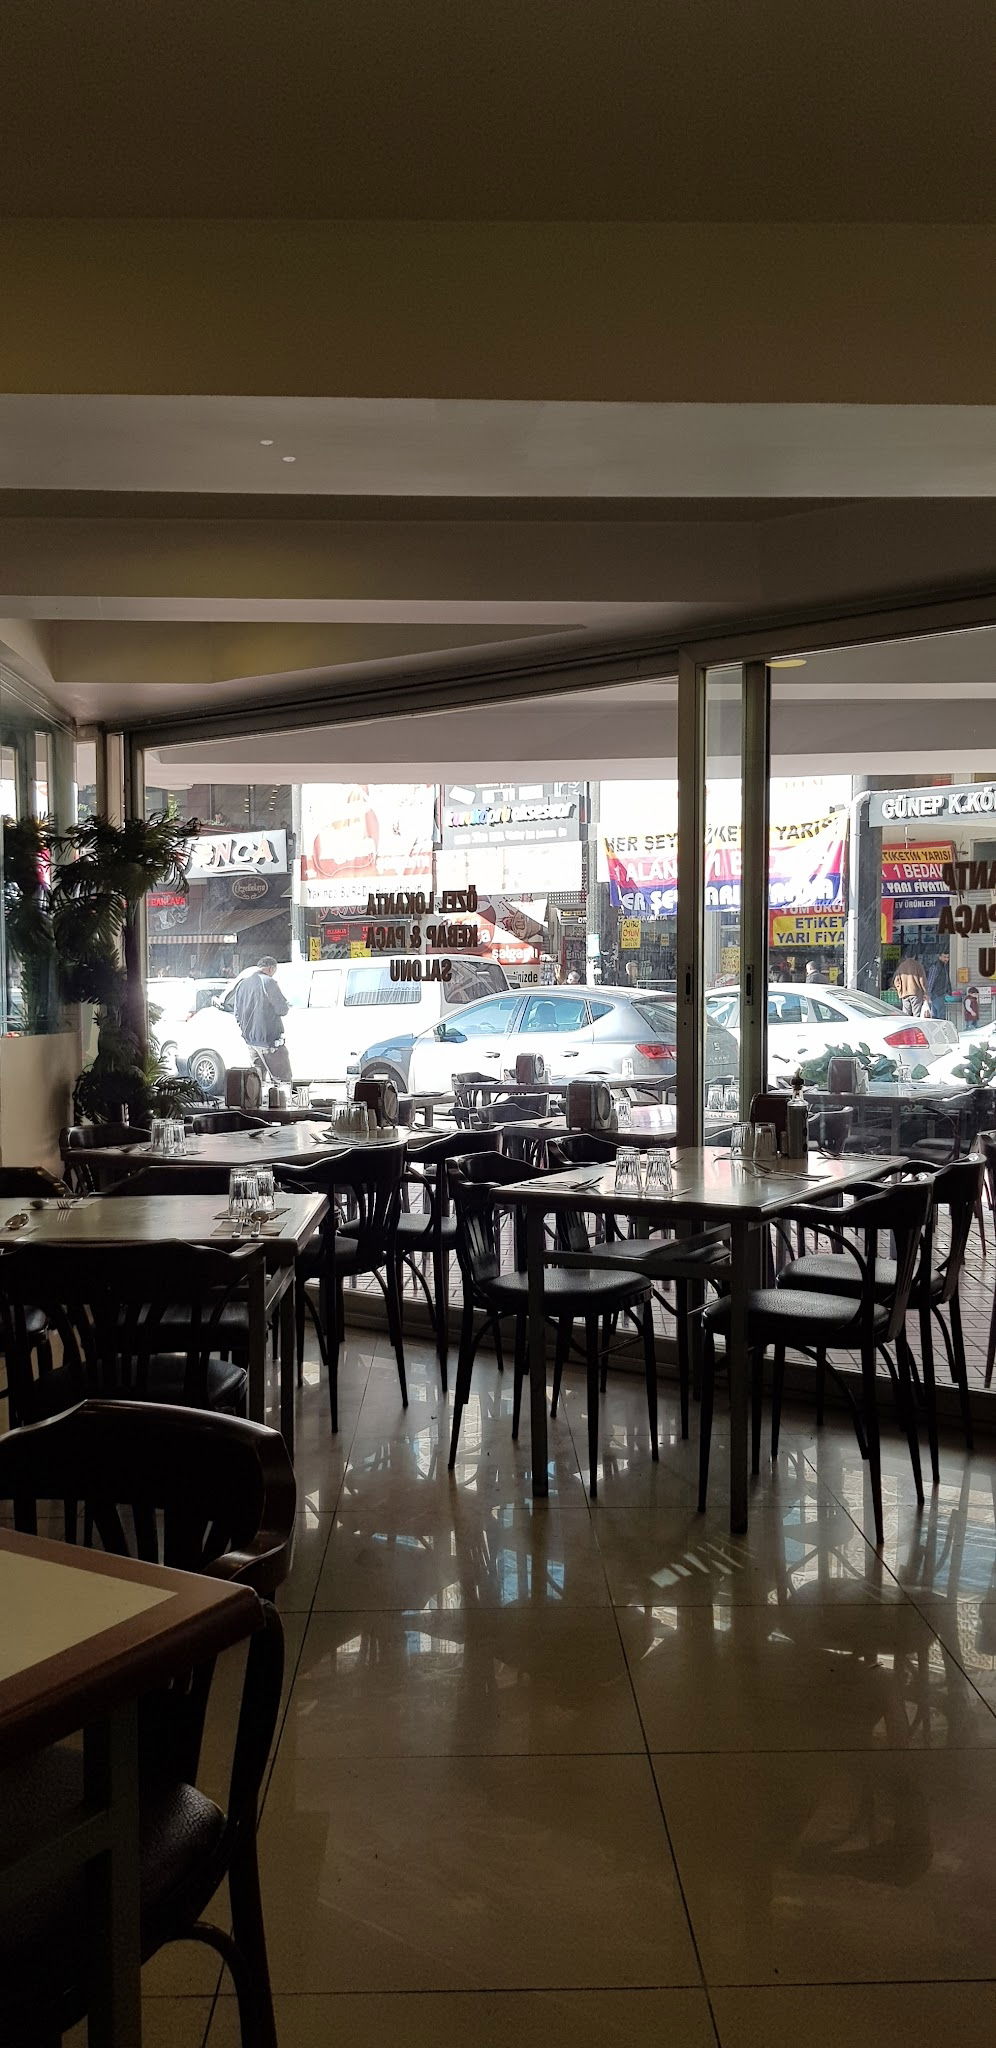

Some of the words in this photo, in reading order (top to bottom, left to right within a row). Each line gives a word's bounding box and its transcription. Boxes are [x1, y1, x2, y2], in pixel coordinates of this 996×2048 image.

[882, 795, 944, 819] GÜNEP
[949, 787, 996, 814] K.KÖ
[882, 850, 921, 861] TİKETİN
[627, 858, 678, 882] ALAN
[903, 864, 943, 878] BEDAV
[776, 932, 810, 944] YARI
[815, 931, 845, 943] FİYA
